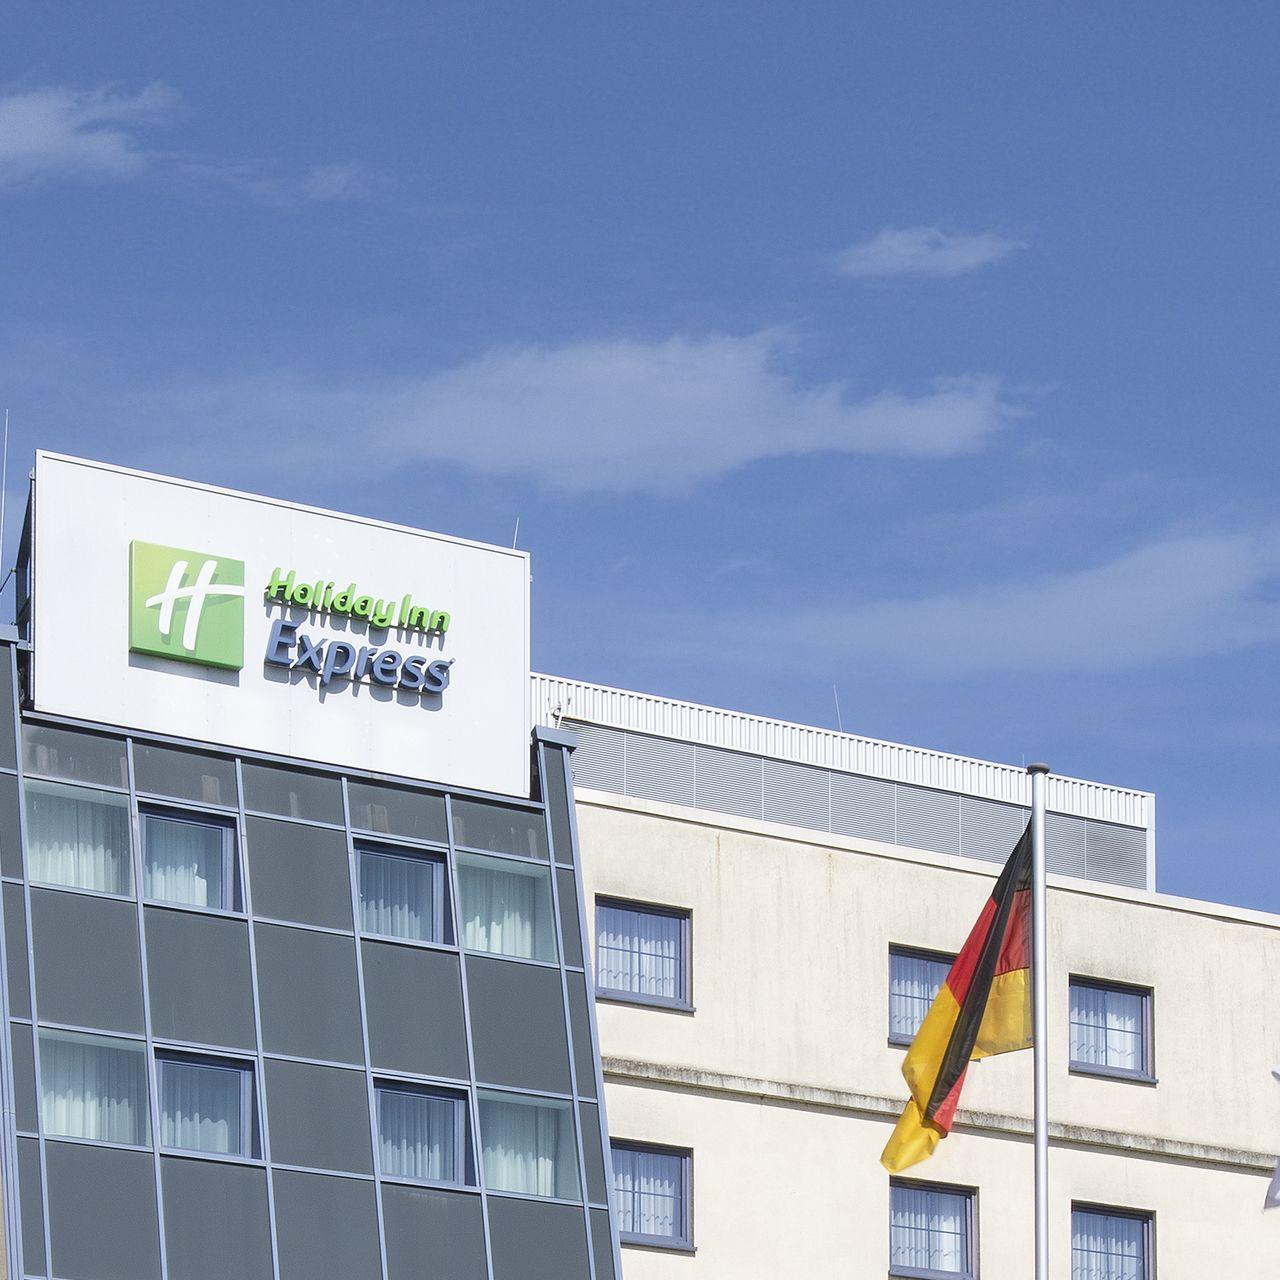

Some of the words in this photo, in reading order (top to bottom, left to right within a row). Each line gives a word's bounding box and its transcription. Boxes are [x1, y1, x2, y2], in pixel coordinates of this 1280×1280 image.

[145, 560, 245, 651] H
[266, 567, 396, 630] Holiday
[397, 593, 451, 634] Inn
[264, 618, 455, 695] Express
